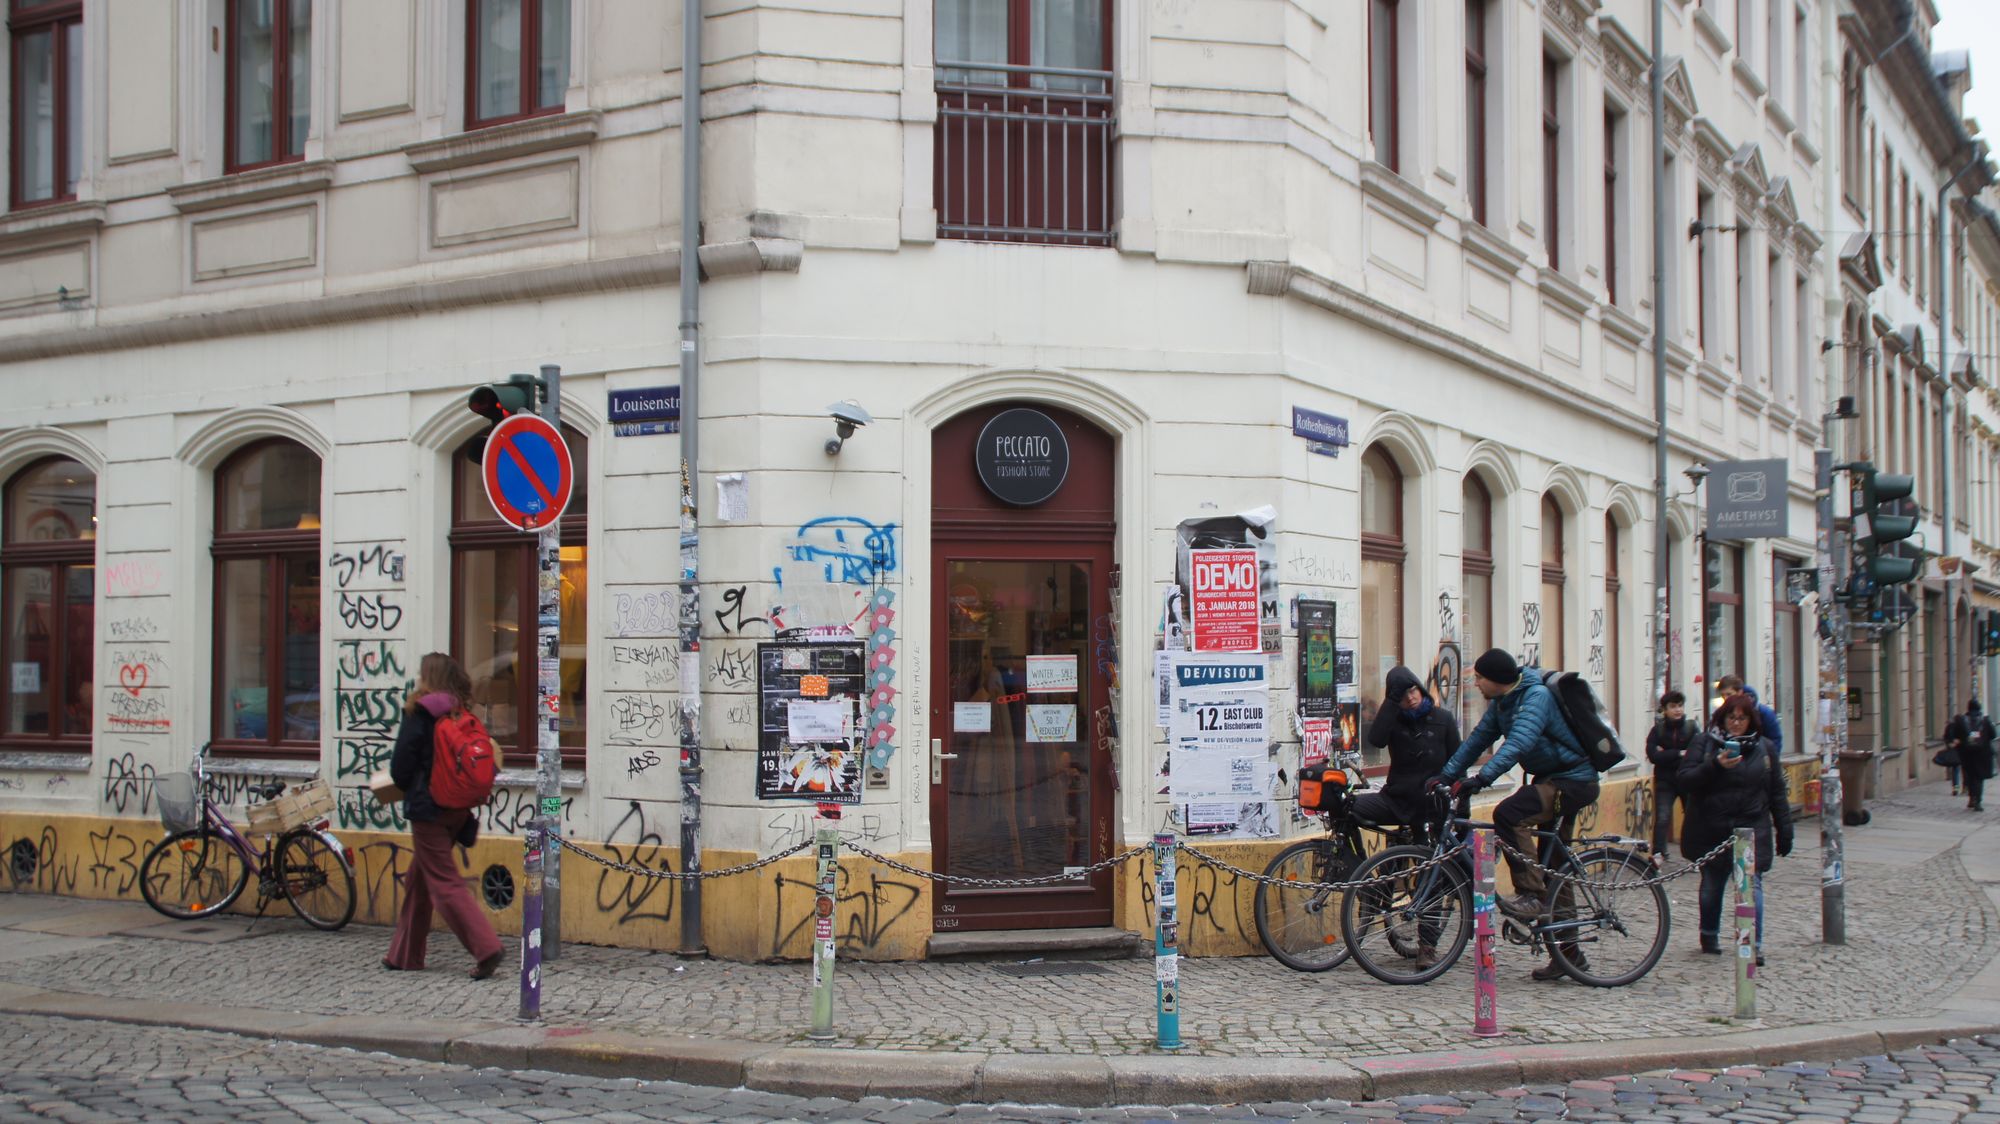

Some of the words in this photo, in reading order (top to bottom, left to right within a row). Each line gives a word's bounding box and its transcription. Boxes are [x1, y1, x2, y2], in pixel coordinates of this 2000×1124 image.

[1296, 414, 1337, 438] Rothenburger
[996, 435, 1050, 457] PECCATO
[997, 465, 1027, 477] FASHION
[1029, 465, 1051, 477] STORE
[1717, 509, 1778, 521] AMETHYST
[1195, 563, 1254, 590] DEMO
[1197, 602, 1208, 611] 26.
[1209, 601, 1238, 610] JANUAR
[1239, 600, 1256, 610] 2019
[1031, 668, 1054, 679] WINTER
[1183, 667, 1256, 679] DE/VISION
[1196, 707, 1222, 731] 1.2.
[1223, 707, 1242, 720] EAST
[1243, 707, 1264, 720] CLUB
[1223, 721, 1263, 731] Bischofswerda
[1305, 731, 1330, 758] DEMO
[762, 750, 780, 758] SAMS
